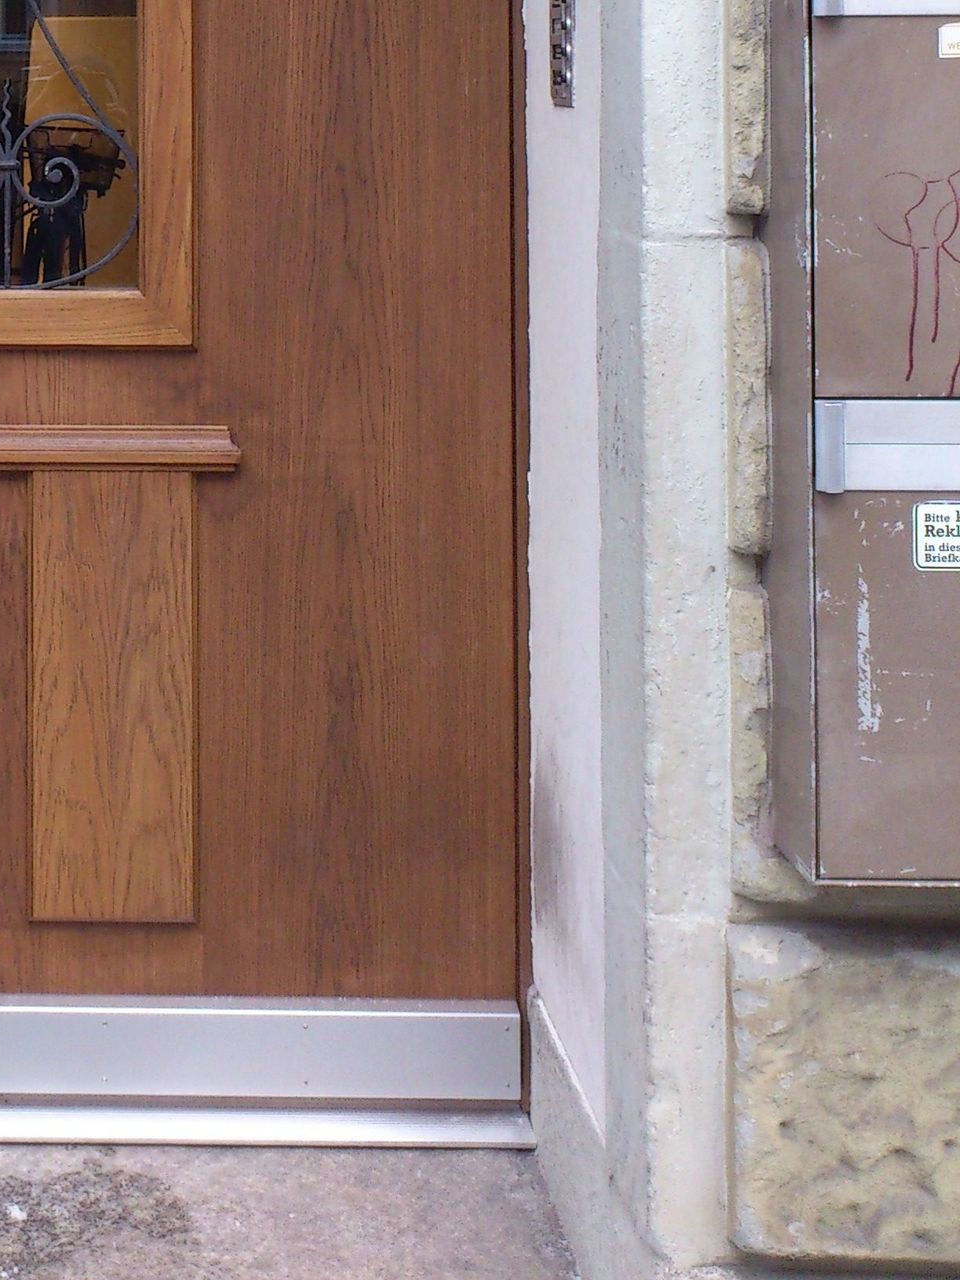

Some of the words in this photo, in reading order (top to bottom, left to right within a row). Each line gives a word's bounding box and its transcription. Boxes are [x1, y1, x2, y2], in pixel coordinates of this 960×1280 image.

[924, 513, 950, 522] Bitte
[925, 542, 935, 551] in
[925, 553, 960, 562] Briefk
